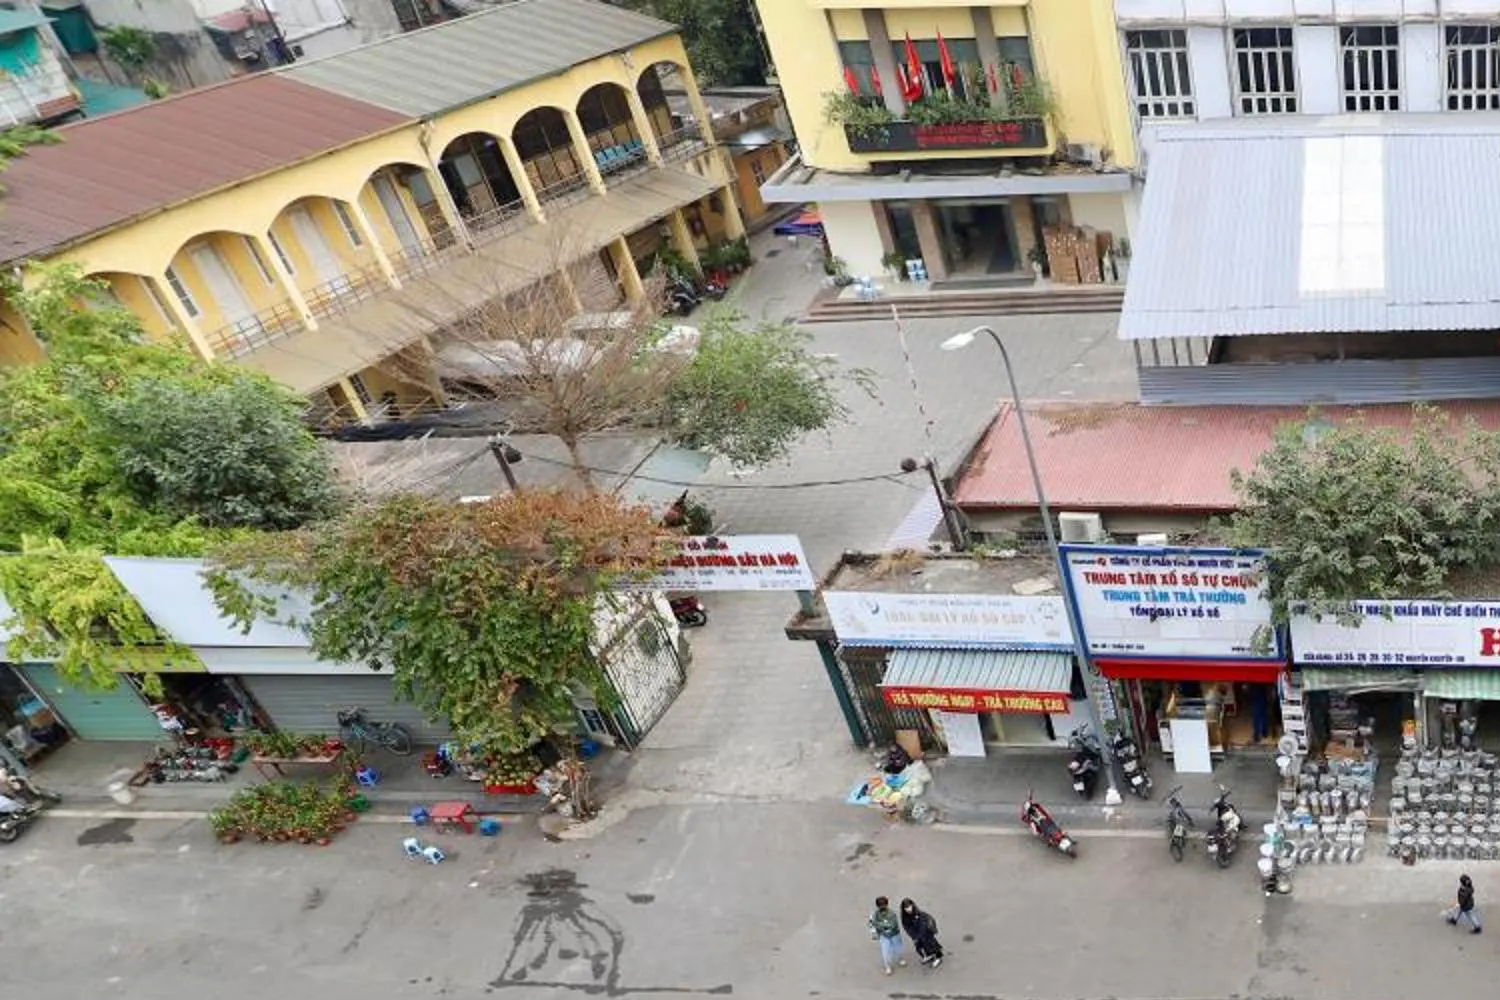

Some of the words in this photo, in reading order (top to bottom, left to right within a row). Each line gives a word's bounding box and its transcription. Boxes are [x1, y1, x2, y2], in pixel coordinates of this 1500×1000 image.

[1083, 571, 1126, 585] TRUNG
[1129, 571, 1158, 586] TÂM
[1161, 569, 1178, 586] XỔ
[1181, 571, 1199, 586] SỐ
[1202, 573, 1219, 588] TỰ
[1102, 589, 1141, 603] TRUNG
[1143, 588, 1170, 603] TÂM
[1174, 588, 1197, 604] TRẢ
